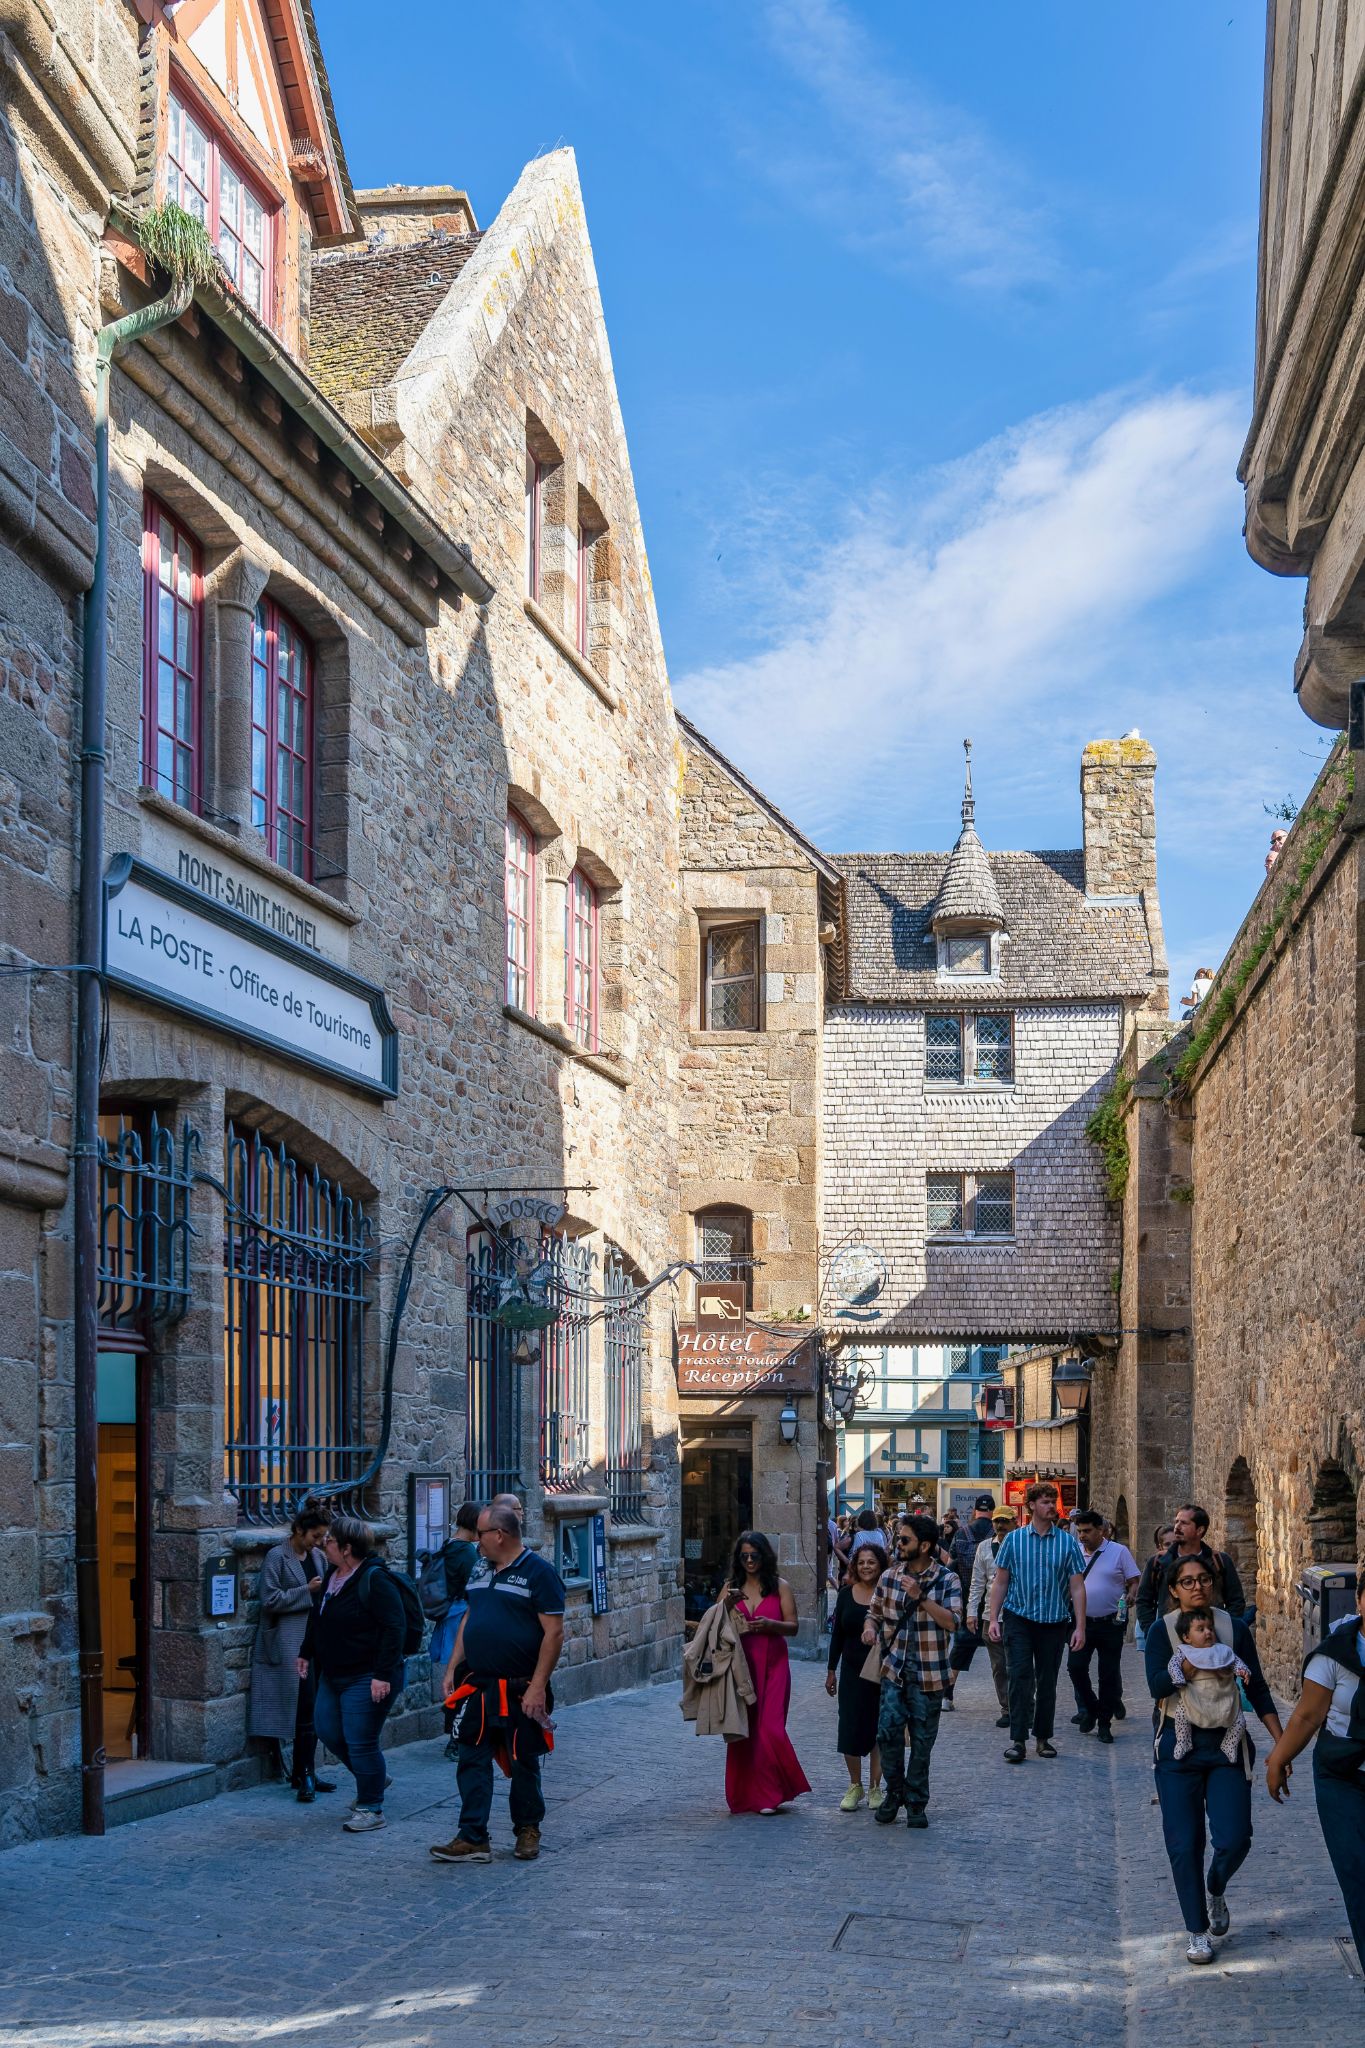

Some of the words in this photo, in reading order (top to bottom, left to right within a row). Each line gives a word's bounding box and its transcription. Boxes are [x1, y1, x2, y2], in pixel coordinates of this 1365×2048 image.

[118, 909, 144, 945] LA
[150, 926, 213, 977] POSTE
[229, 965, 279, 1007] Office
[283, 991, 303, 1018] de
[306, 1001, 371, 1050] Tourisme
[495, 1199, 559, 1223] POSTE
[678, 1332, 759, 1352] Hôtel
[678, 1356, 730, 1366] rrasses
[736, 1354, 801, 1366] Poulard
[684, 1369, 785, 1387] Réception
